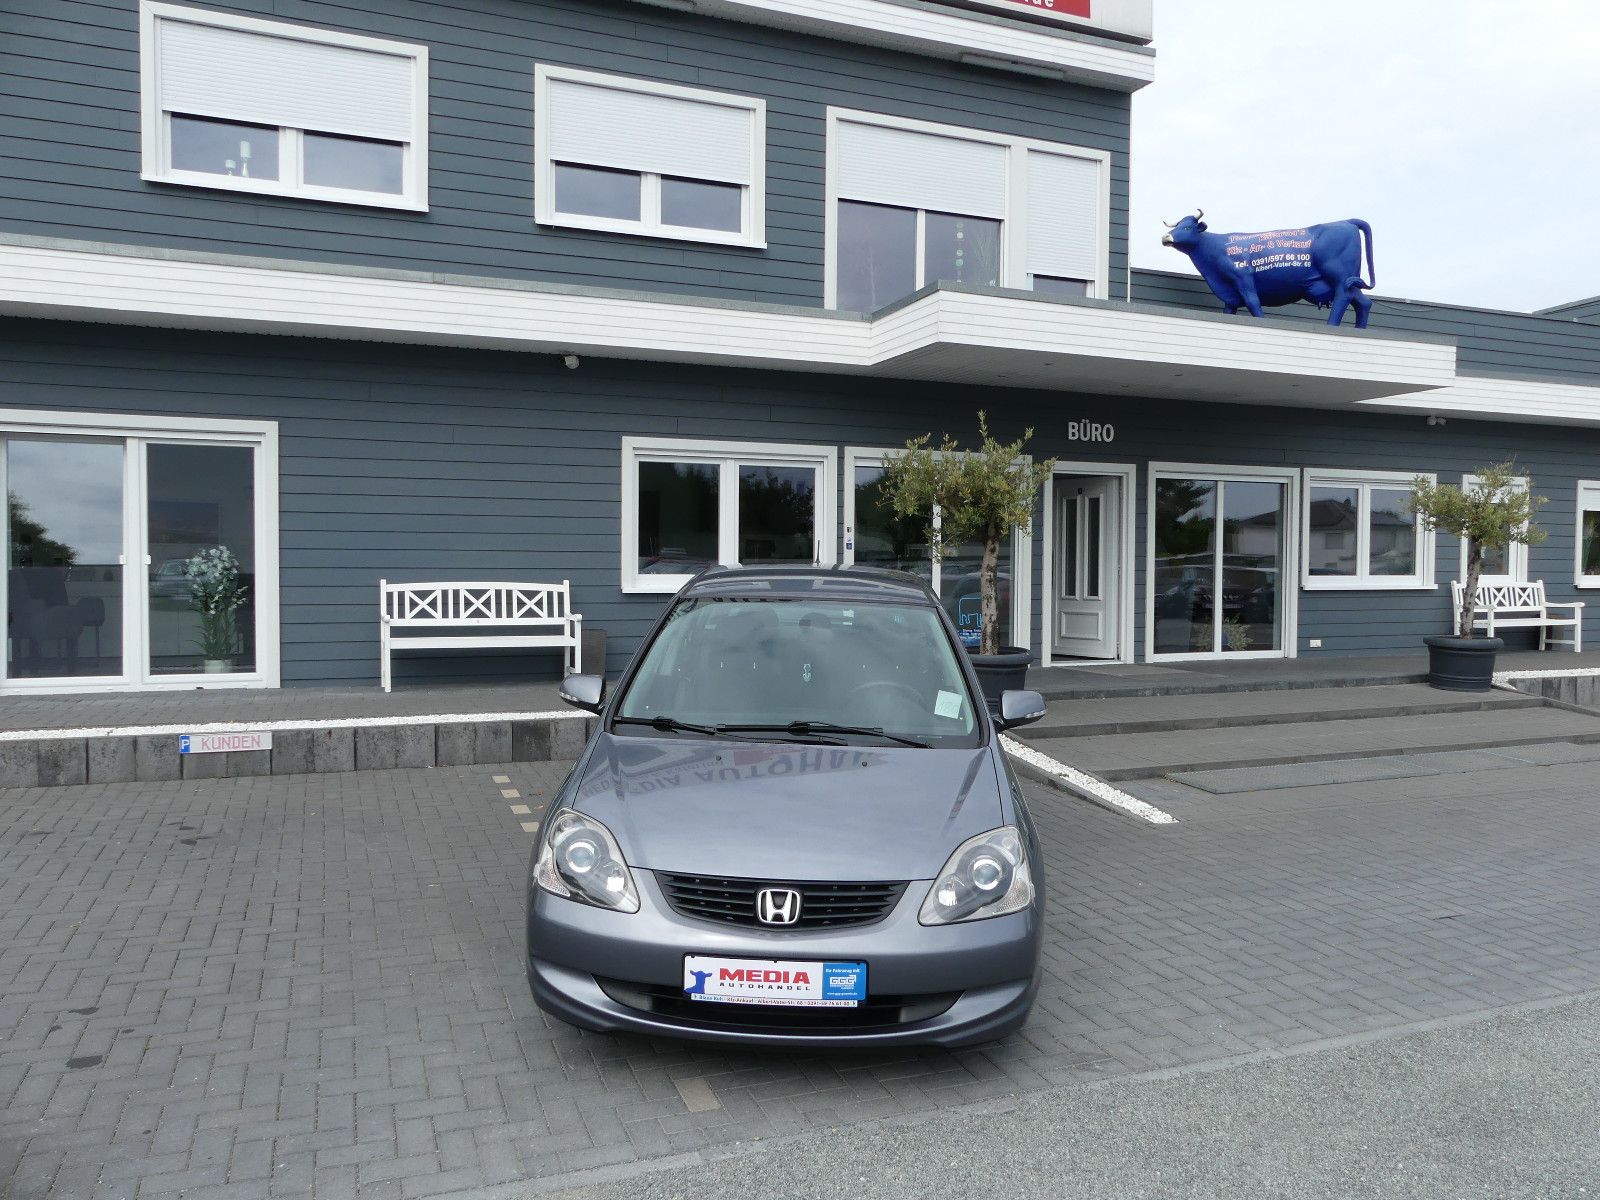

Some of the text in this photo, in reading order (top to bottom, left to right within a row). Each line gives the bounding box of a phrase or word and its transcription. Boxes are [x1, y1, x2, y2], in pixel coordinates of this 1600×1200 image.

[1276, 239, 1312, 249] Verkauf
[1233, 261, 1249, 269] Tel.
[1296, 253, 1310, 261] 100
[1068, 418, 1115, 442] BÜRO
[181, 738, 190, 750] P
[202, 734, 261, 751] KUNDEN
[719, 968, 811, 985] MEDIA
[719, 982, 811, 991] AUTOHANDEL
